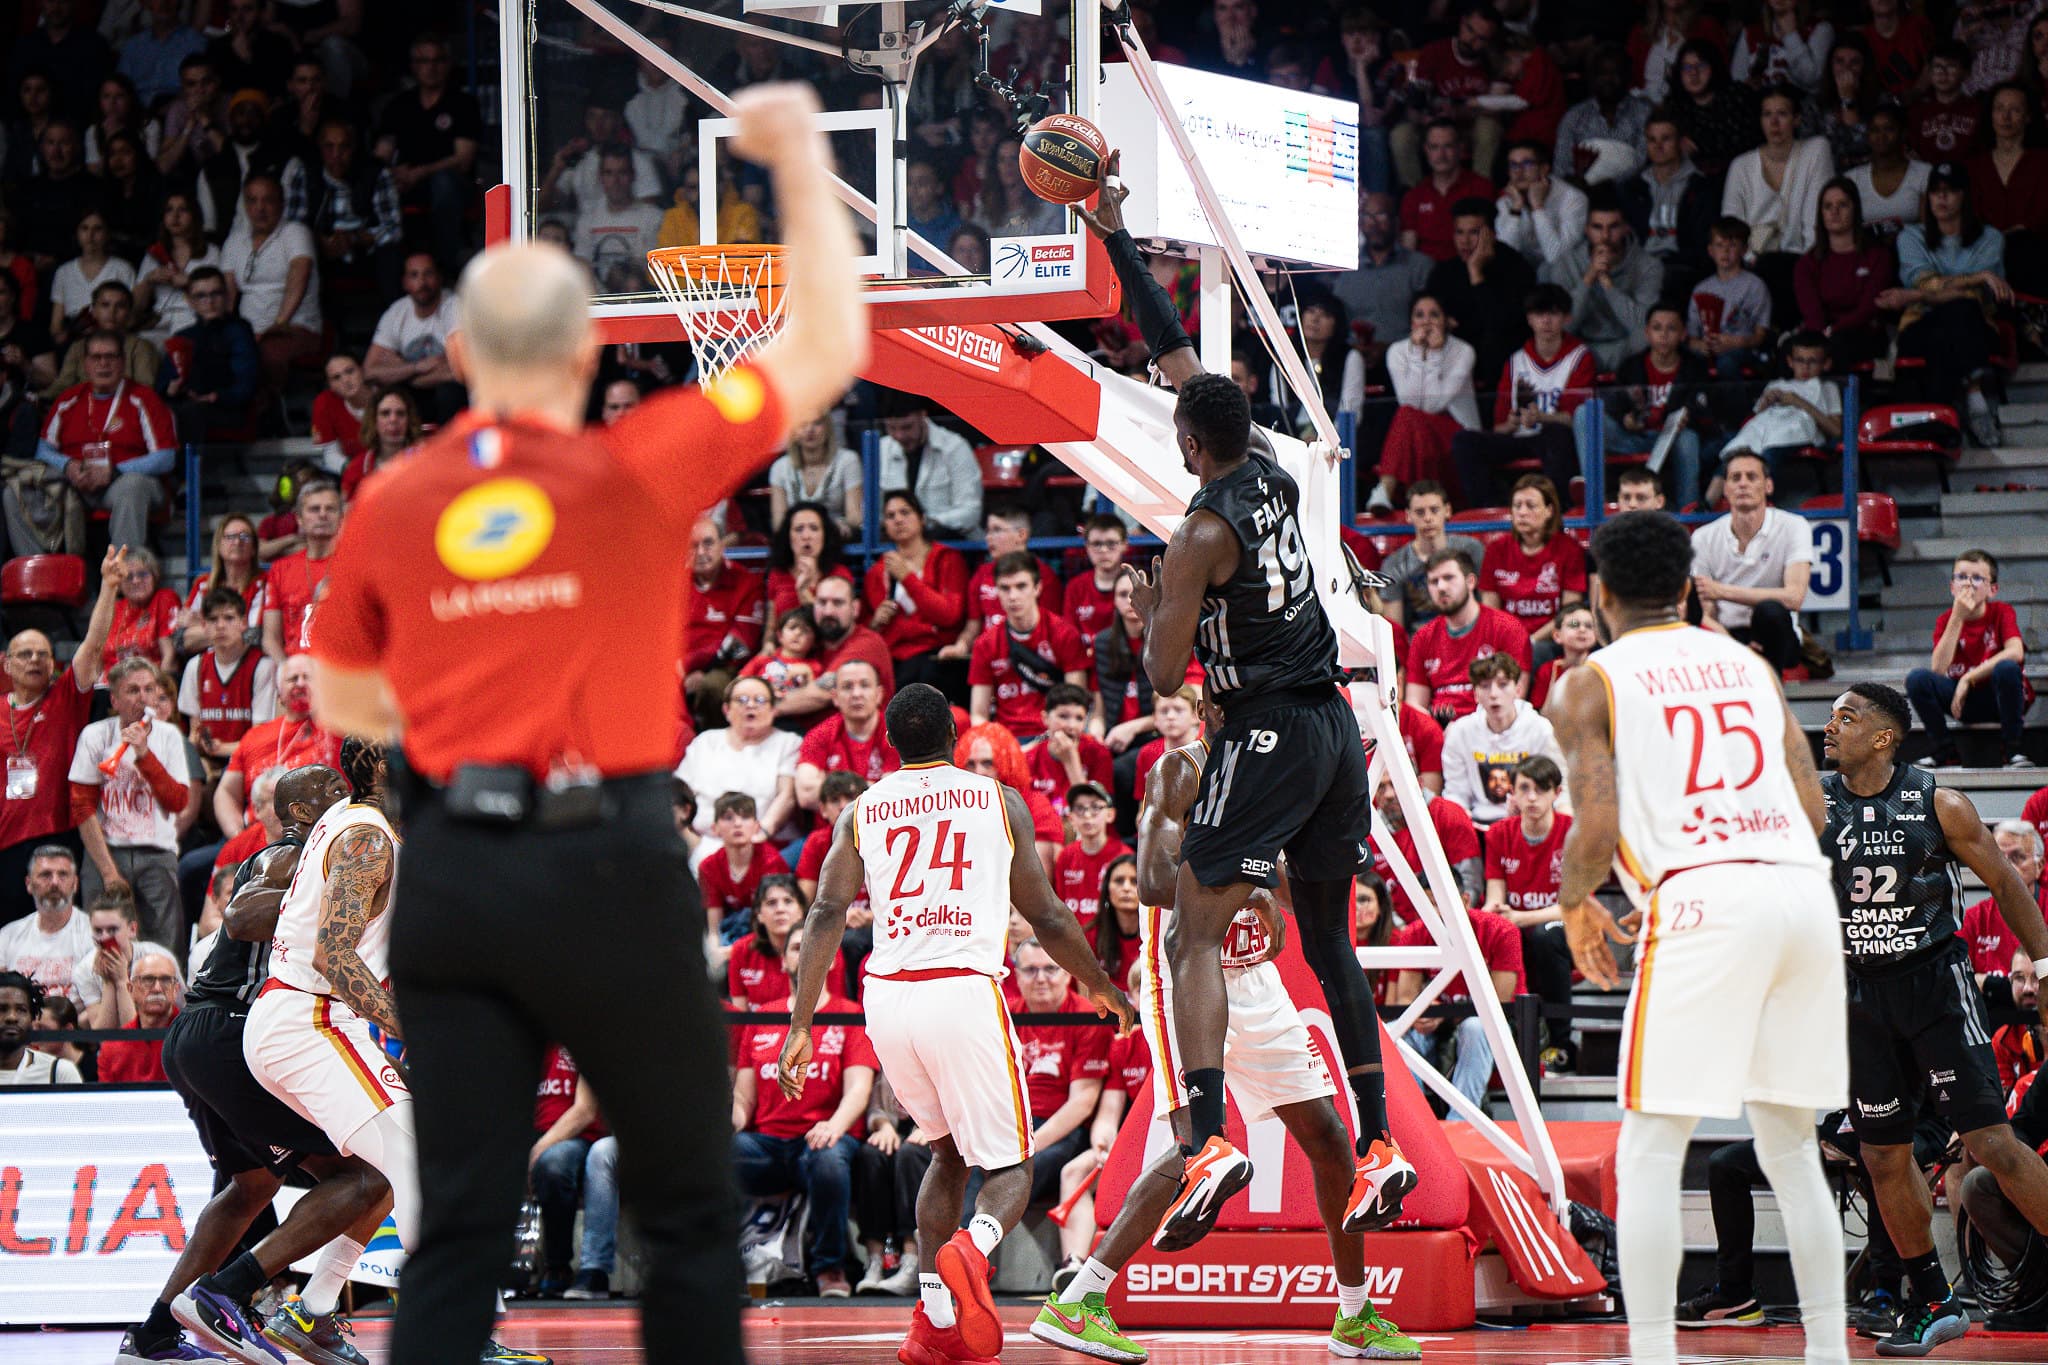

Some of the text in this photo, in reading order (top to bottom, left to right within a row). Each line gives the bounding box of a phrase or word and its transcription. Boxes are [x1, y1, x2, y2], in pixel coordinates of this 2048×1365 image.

[1052, 117, 1102, 147] Betclic
[1037, 138, 1096, 177] SPALDING
[1034, 247, 1071, 261] Betclic
[1034, 264, 1071, 278] ÉLITE
[1252, 490, 1287, 536] FALL
[1257, 514, 1310, 613] 19
[1808, 522, 1843, 597] 3
[1635, 661, 1754, 696] WALKER
[1246, 729, 1279, 754] 19
[1663, 700, 1765, 797] 25
[866, 788, 990, 825] HOUMOUNOU
[1901, 790, 1922, 800] DCB
[1863, 830, 1905, 844] LDLC
[1863, 845, 1906, 856] ASVEL
[885, 819, 973, 901] 24
[1850, 866, 1898, 903] 32
[915, 904, 973, 928] dalkia
[1671, 899, 1705, 931] 25
[1851, 905, 1916, 924] SMART
[926, 927, 953, 938] GROUPE
[1846, 923, 1899, 940] GOOD
[1851, 935, 1918, 956] THINGS
[1126, 1264, 1404, 1296] SPORTSYSTM
